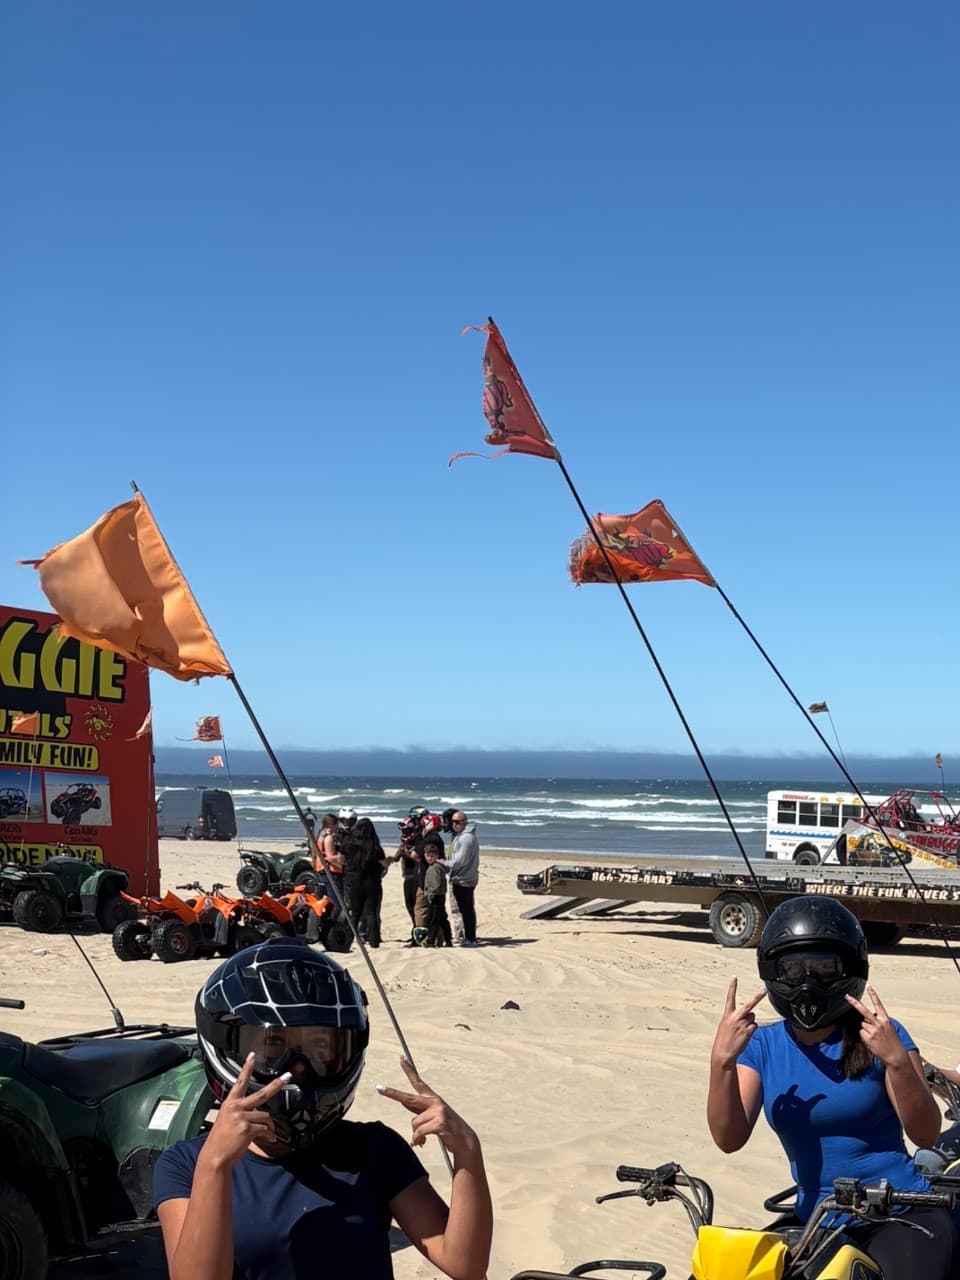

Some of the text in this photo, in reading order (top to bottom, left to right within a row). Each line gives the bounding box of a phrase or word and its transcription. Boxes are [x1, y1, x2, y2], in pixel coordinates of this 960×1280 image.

[49, 744, 93, 769] FUN!
[805, 883, 848, 895] WHERE
[851, 886, 877, 897] THE
[878, 887, 904, 898] FUN
[907, 889, 947, 900] NEVER
